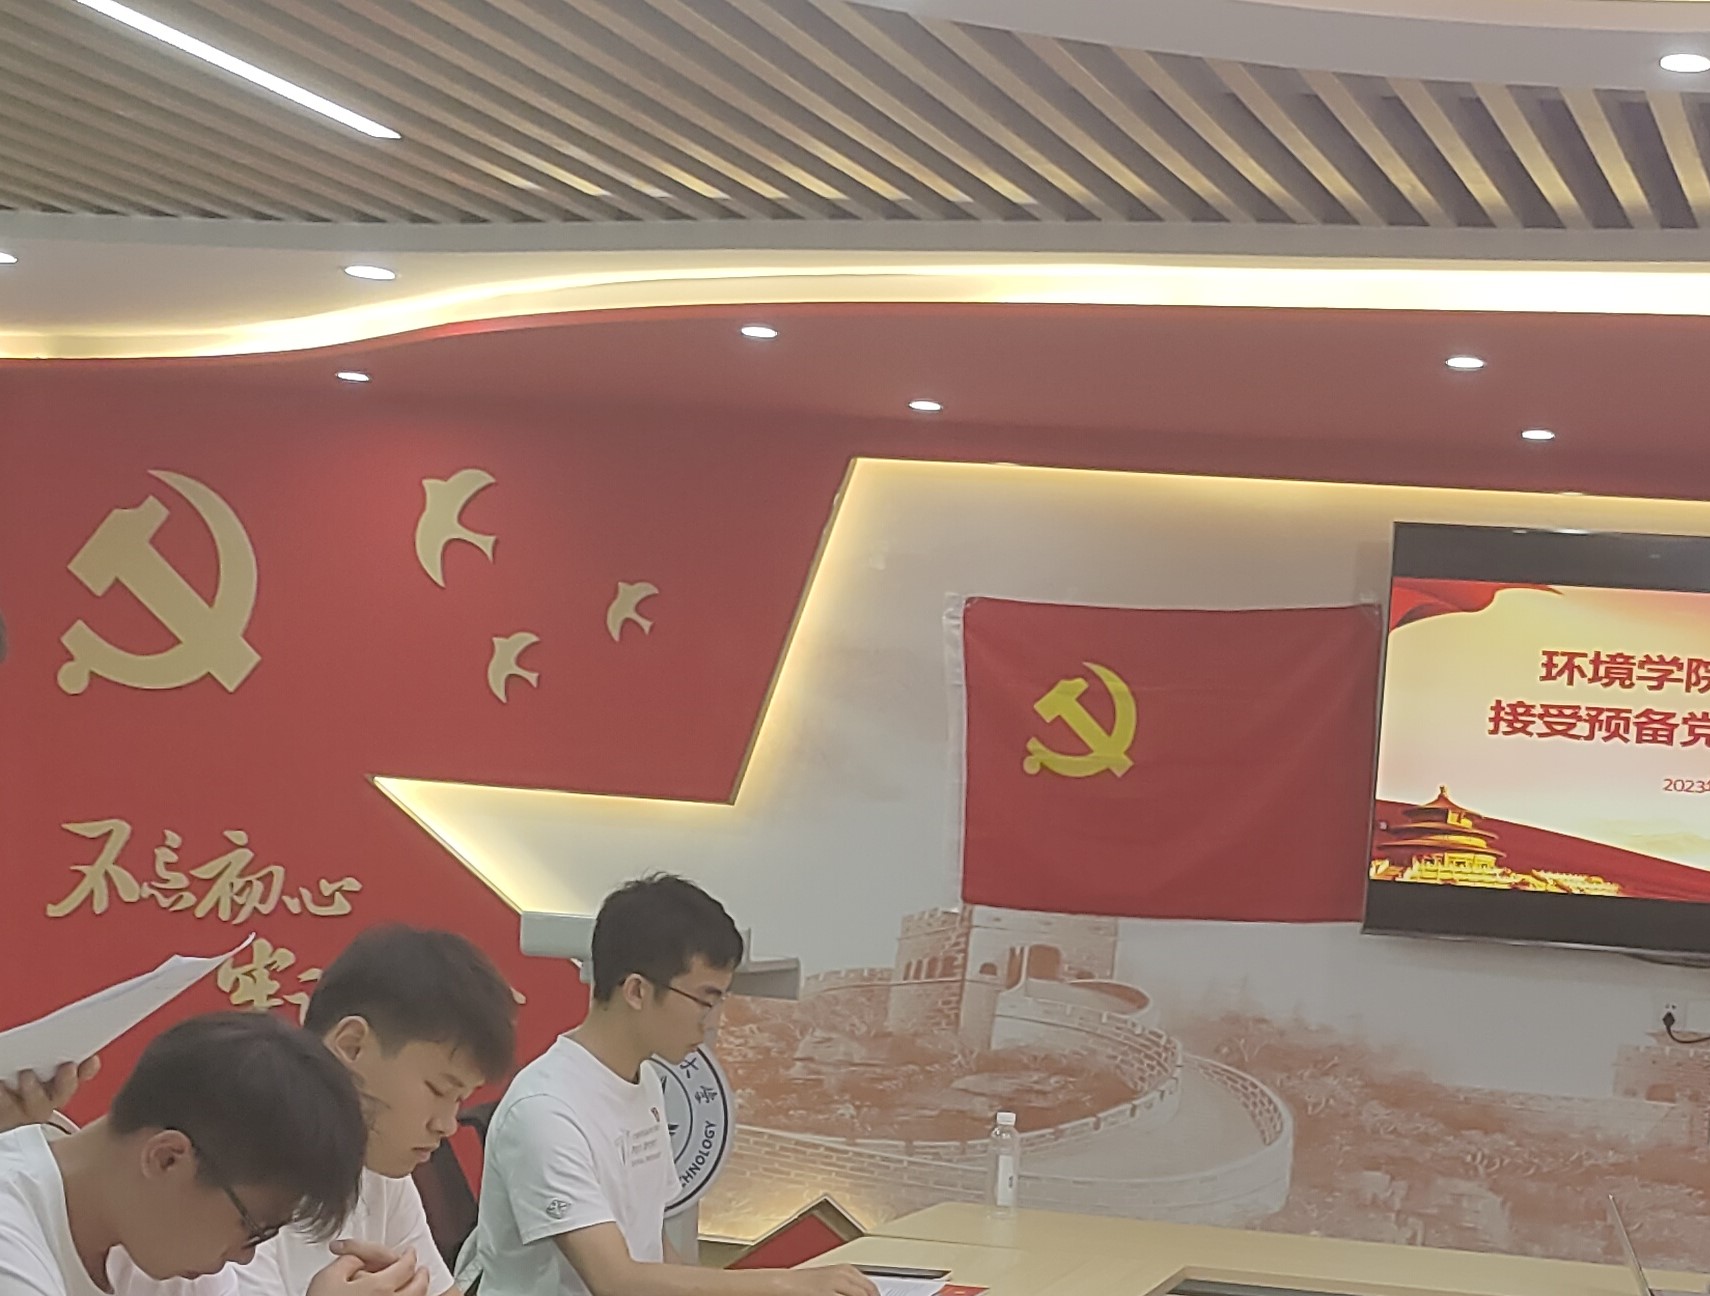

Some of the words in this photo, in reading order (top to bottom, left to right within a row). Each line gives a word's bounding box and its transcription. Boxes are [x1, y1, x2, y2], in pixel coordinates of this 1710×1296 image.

[46, 818, 363, 925] 不忘初心
[679, 1120, 717, 1188] HNOLOGY
